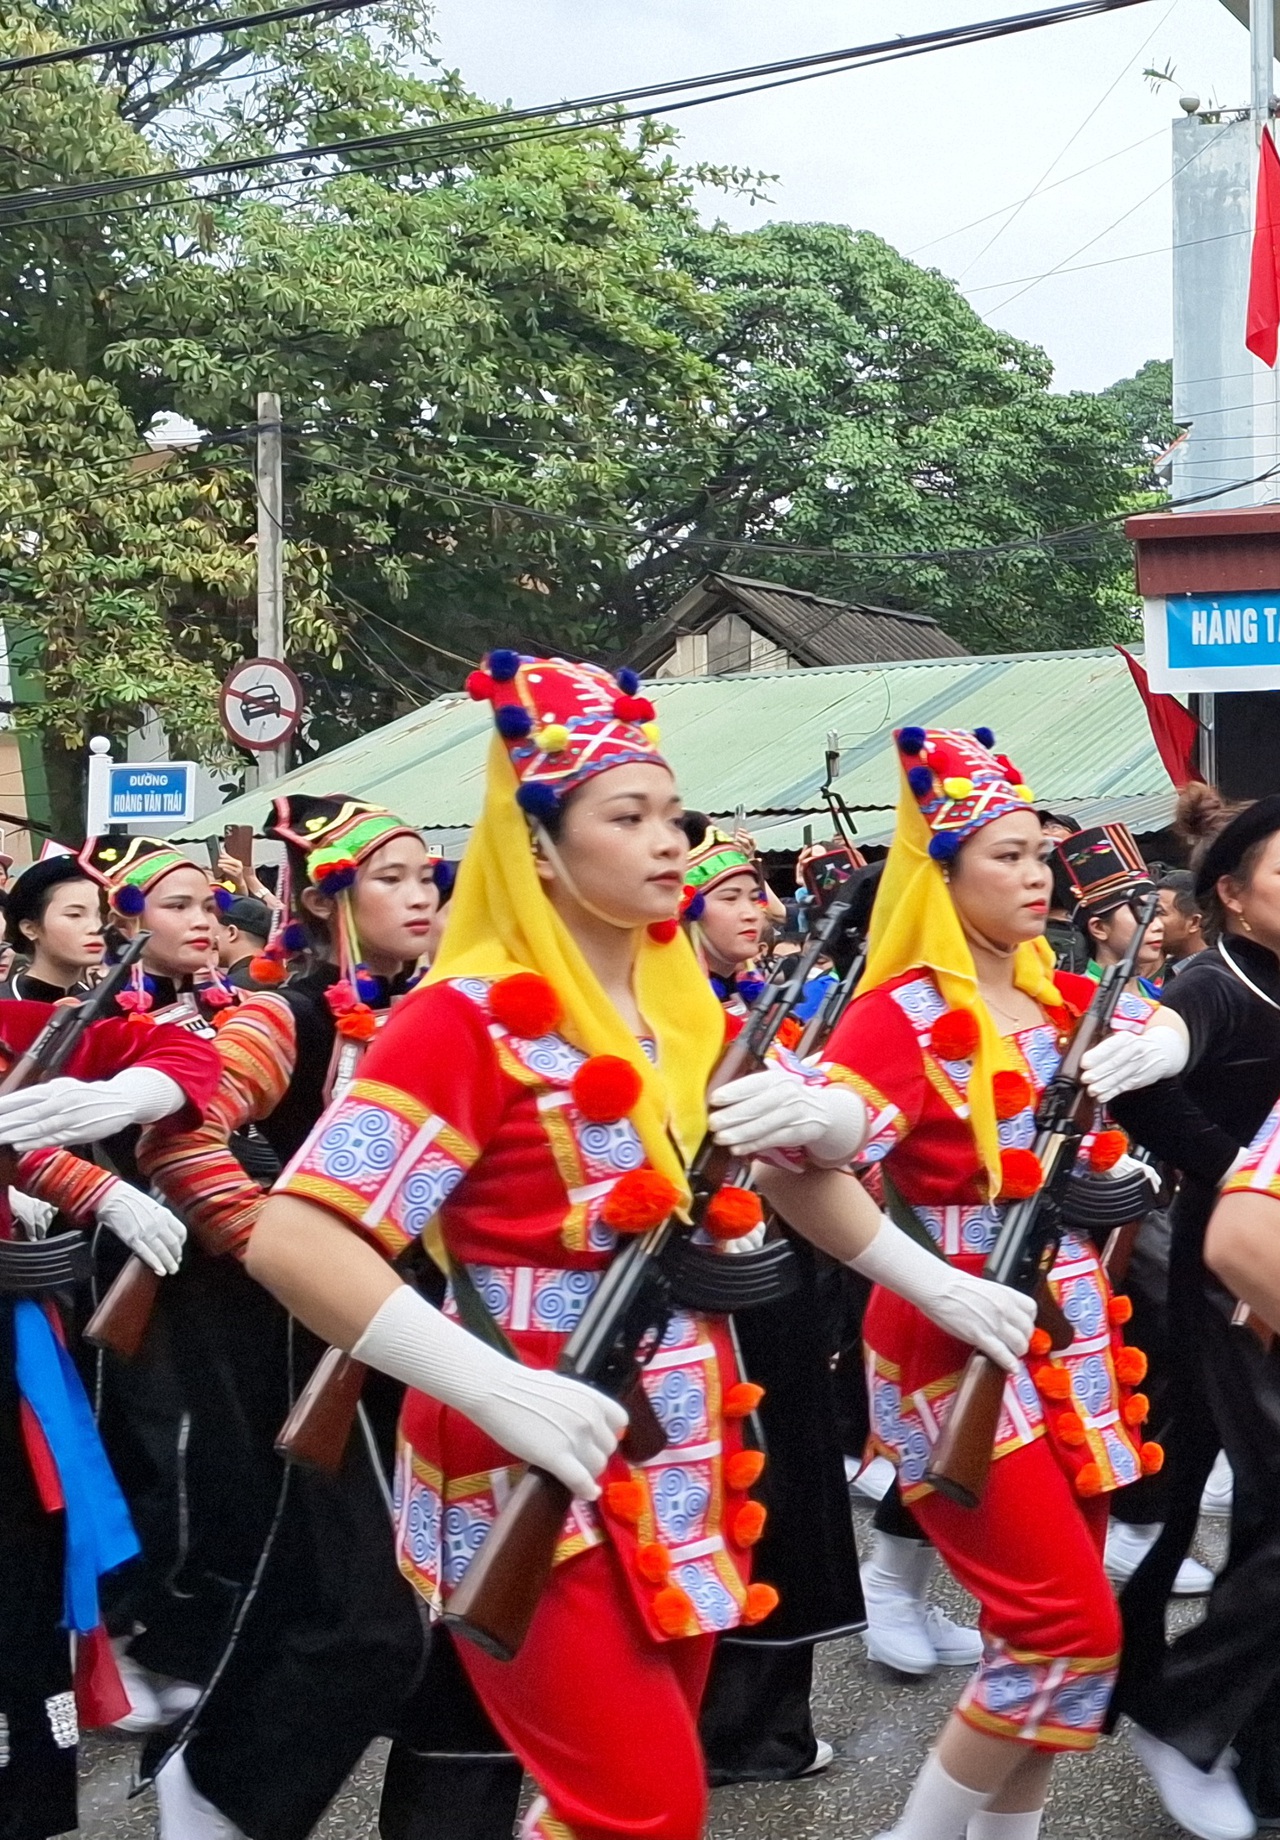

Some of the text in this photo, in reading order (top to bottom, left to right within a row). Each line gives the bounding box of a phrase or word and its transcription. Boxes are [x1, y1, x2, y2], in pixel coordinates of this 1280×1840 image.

[1191, 602, 1258, 645] HÀNG
[129, 771, 169, 787] ĐƯỜNG
[113, 789, 183, 813] HOÀNG VĂN THÁI
